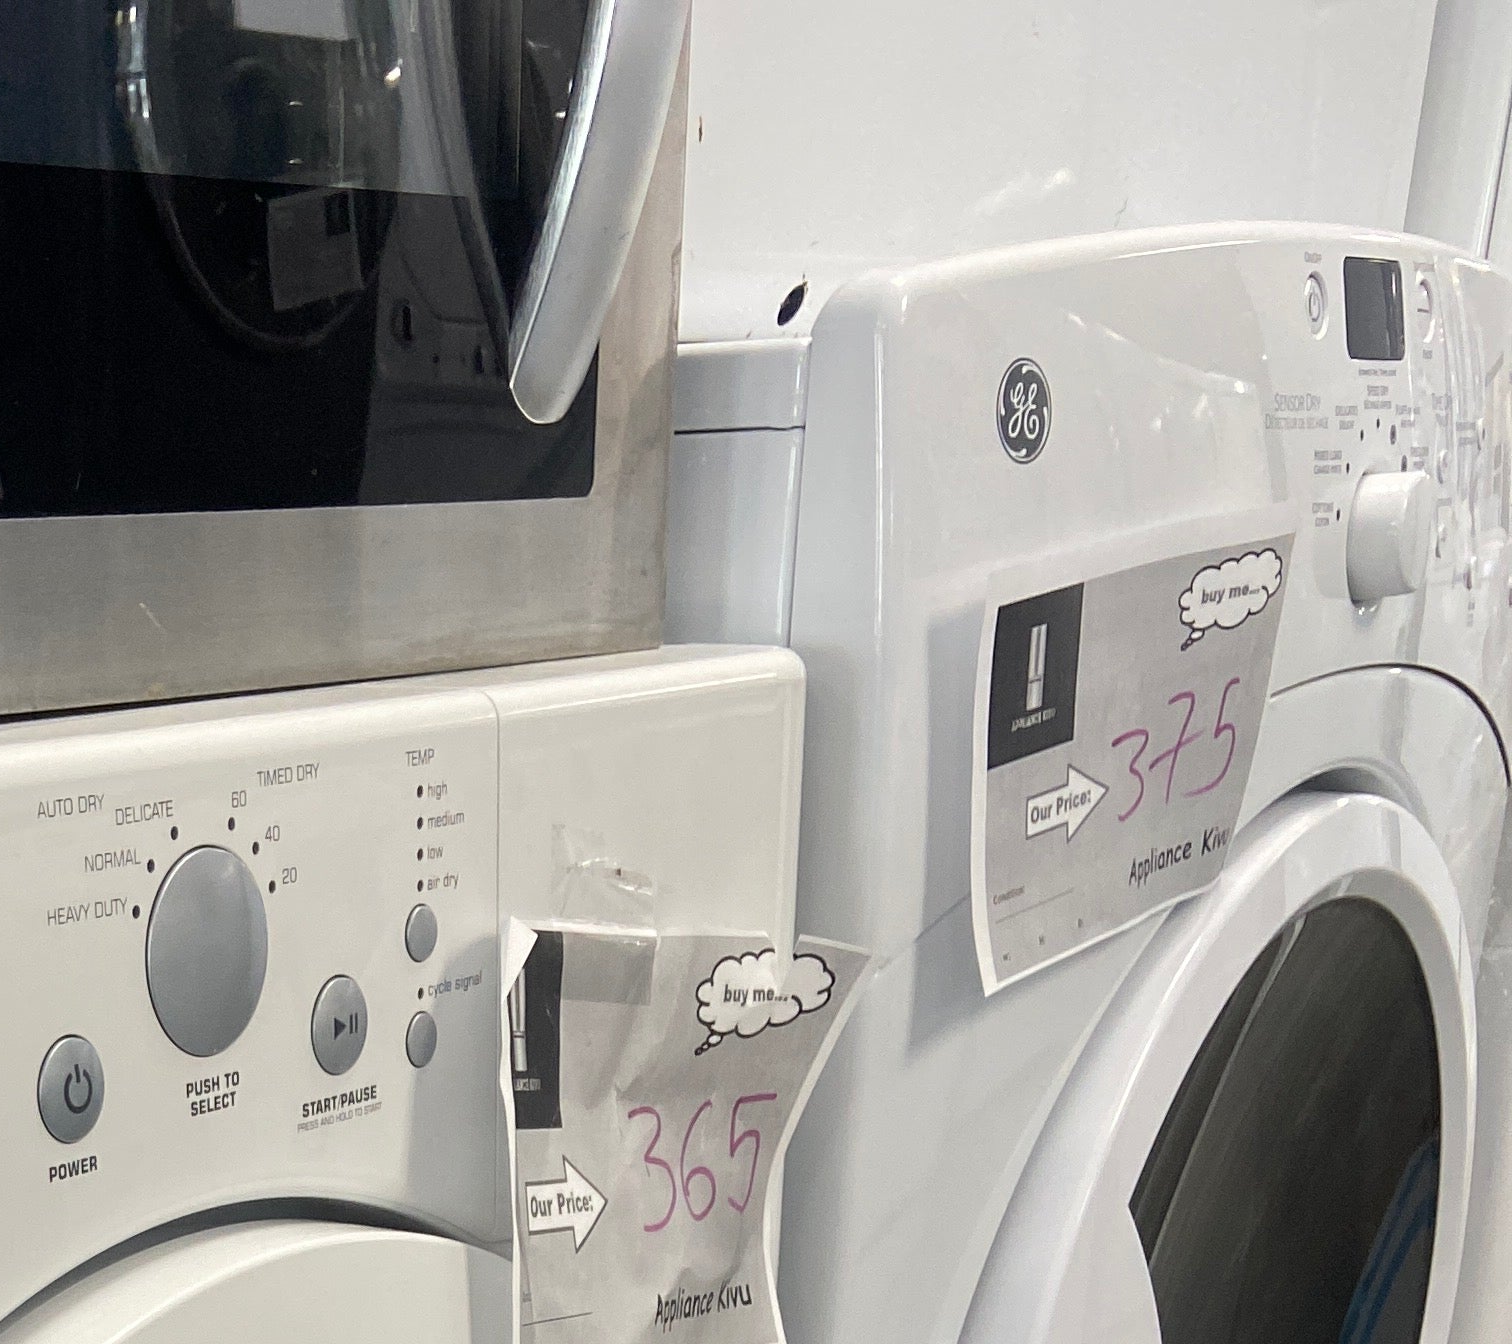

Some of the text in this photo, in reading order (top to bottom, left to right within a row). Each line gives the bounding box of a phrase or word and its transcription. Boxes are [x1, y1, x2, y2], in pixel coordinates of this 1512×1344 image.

[1201, 586, 1225, 605] buy
[405, 748, 435, 768] TEMP
[1111, 677, 1241, 822] 375
[256, 763, 320, 788] TIMED DRY
[231, 790, 247, 808] 60
[427, 781, 448, 800] high
[37, 794, 105, 819] AUTO DRY
[115, 800, 174, 826] DELICATE
[1030, 789, 1092, 824] Our Price:
[427, 809, 465, 830] medium
[264, 825, 280, 842] 40
[84, 849, 141, 873] NORMAL
[427, 844, 444, 861] low
[1129, 841, 1192, 889] Appliance
[281, 867, 298, 885] 20
[427, 872, 460, 891] air dry
[47, 898, 128, 927] HEAVY DUTY
[427, 969, 483, 999] cycle signal
[723, 984, 749, 1006] buy
[185, 1071, 241, 1099] PUSH TO
[189, 1091, 237, 1118] SELECT
[302, 1085, 377, 1118] START/PAUSE
[297, 1101, 383, 1134] PRESS AND HOLD TO START
[48, 1155, 98, 1183] POWER
[627, 1092, 778, 1233] 365
[530, 1193, 595, 1218] Our Price:
[655, 1286, 713, 1334] Appliance
